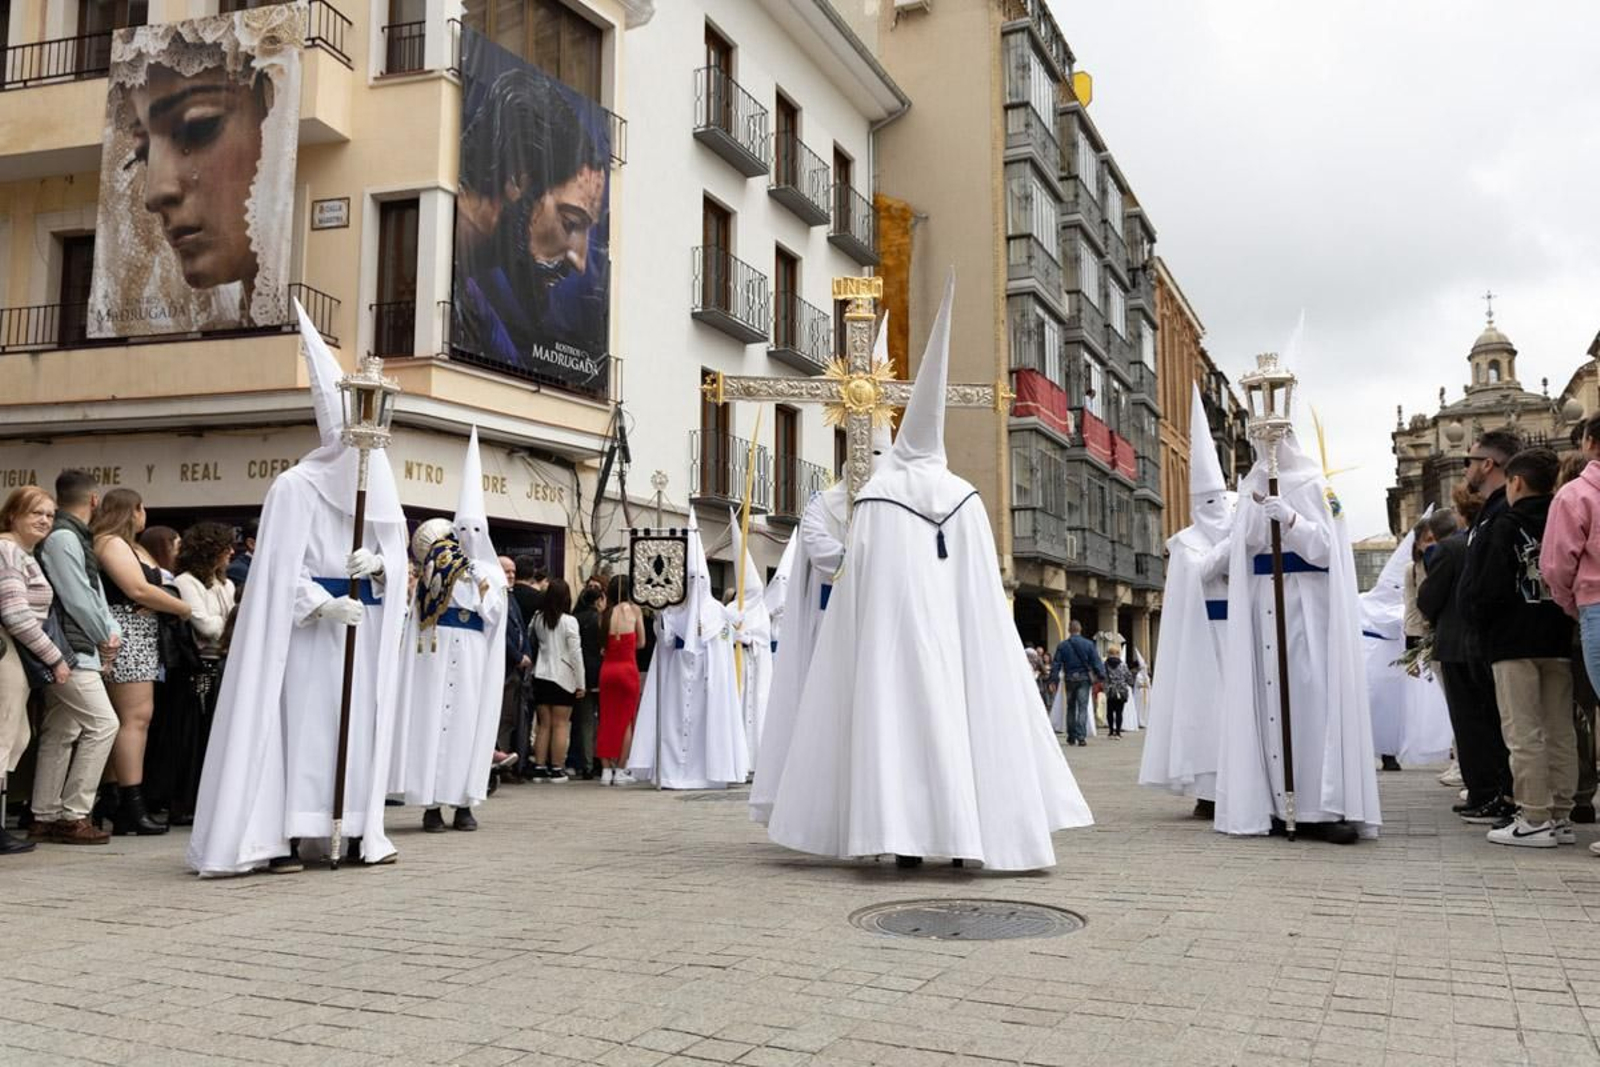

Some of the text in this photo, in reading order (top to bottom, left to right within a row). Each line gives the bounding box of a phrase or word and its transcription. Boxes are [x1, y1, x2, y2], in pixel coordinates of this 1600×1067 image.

[96, 305, 186, 322] MADRUGADA
[146, 464, 156, 483] Y
[180, 462, 222, 482] REAL
[404, 459, 444, 485] NTRO
[482, 474, 508, 495] DRE
